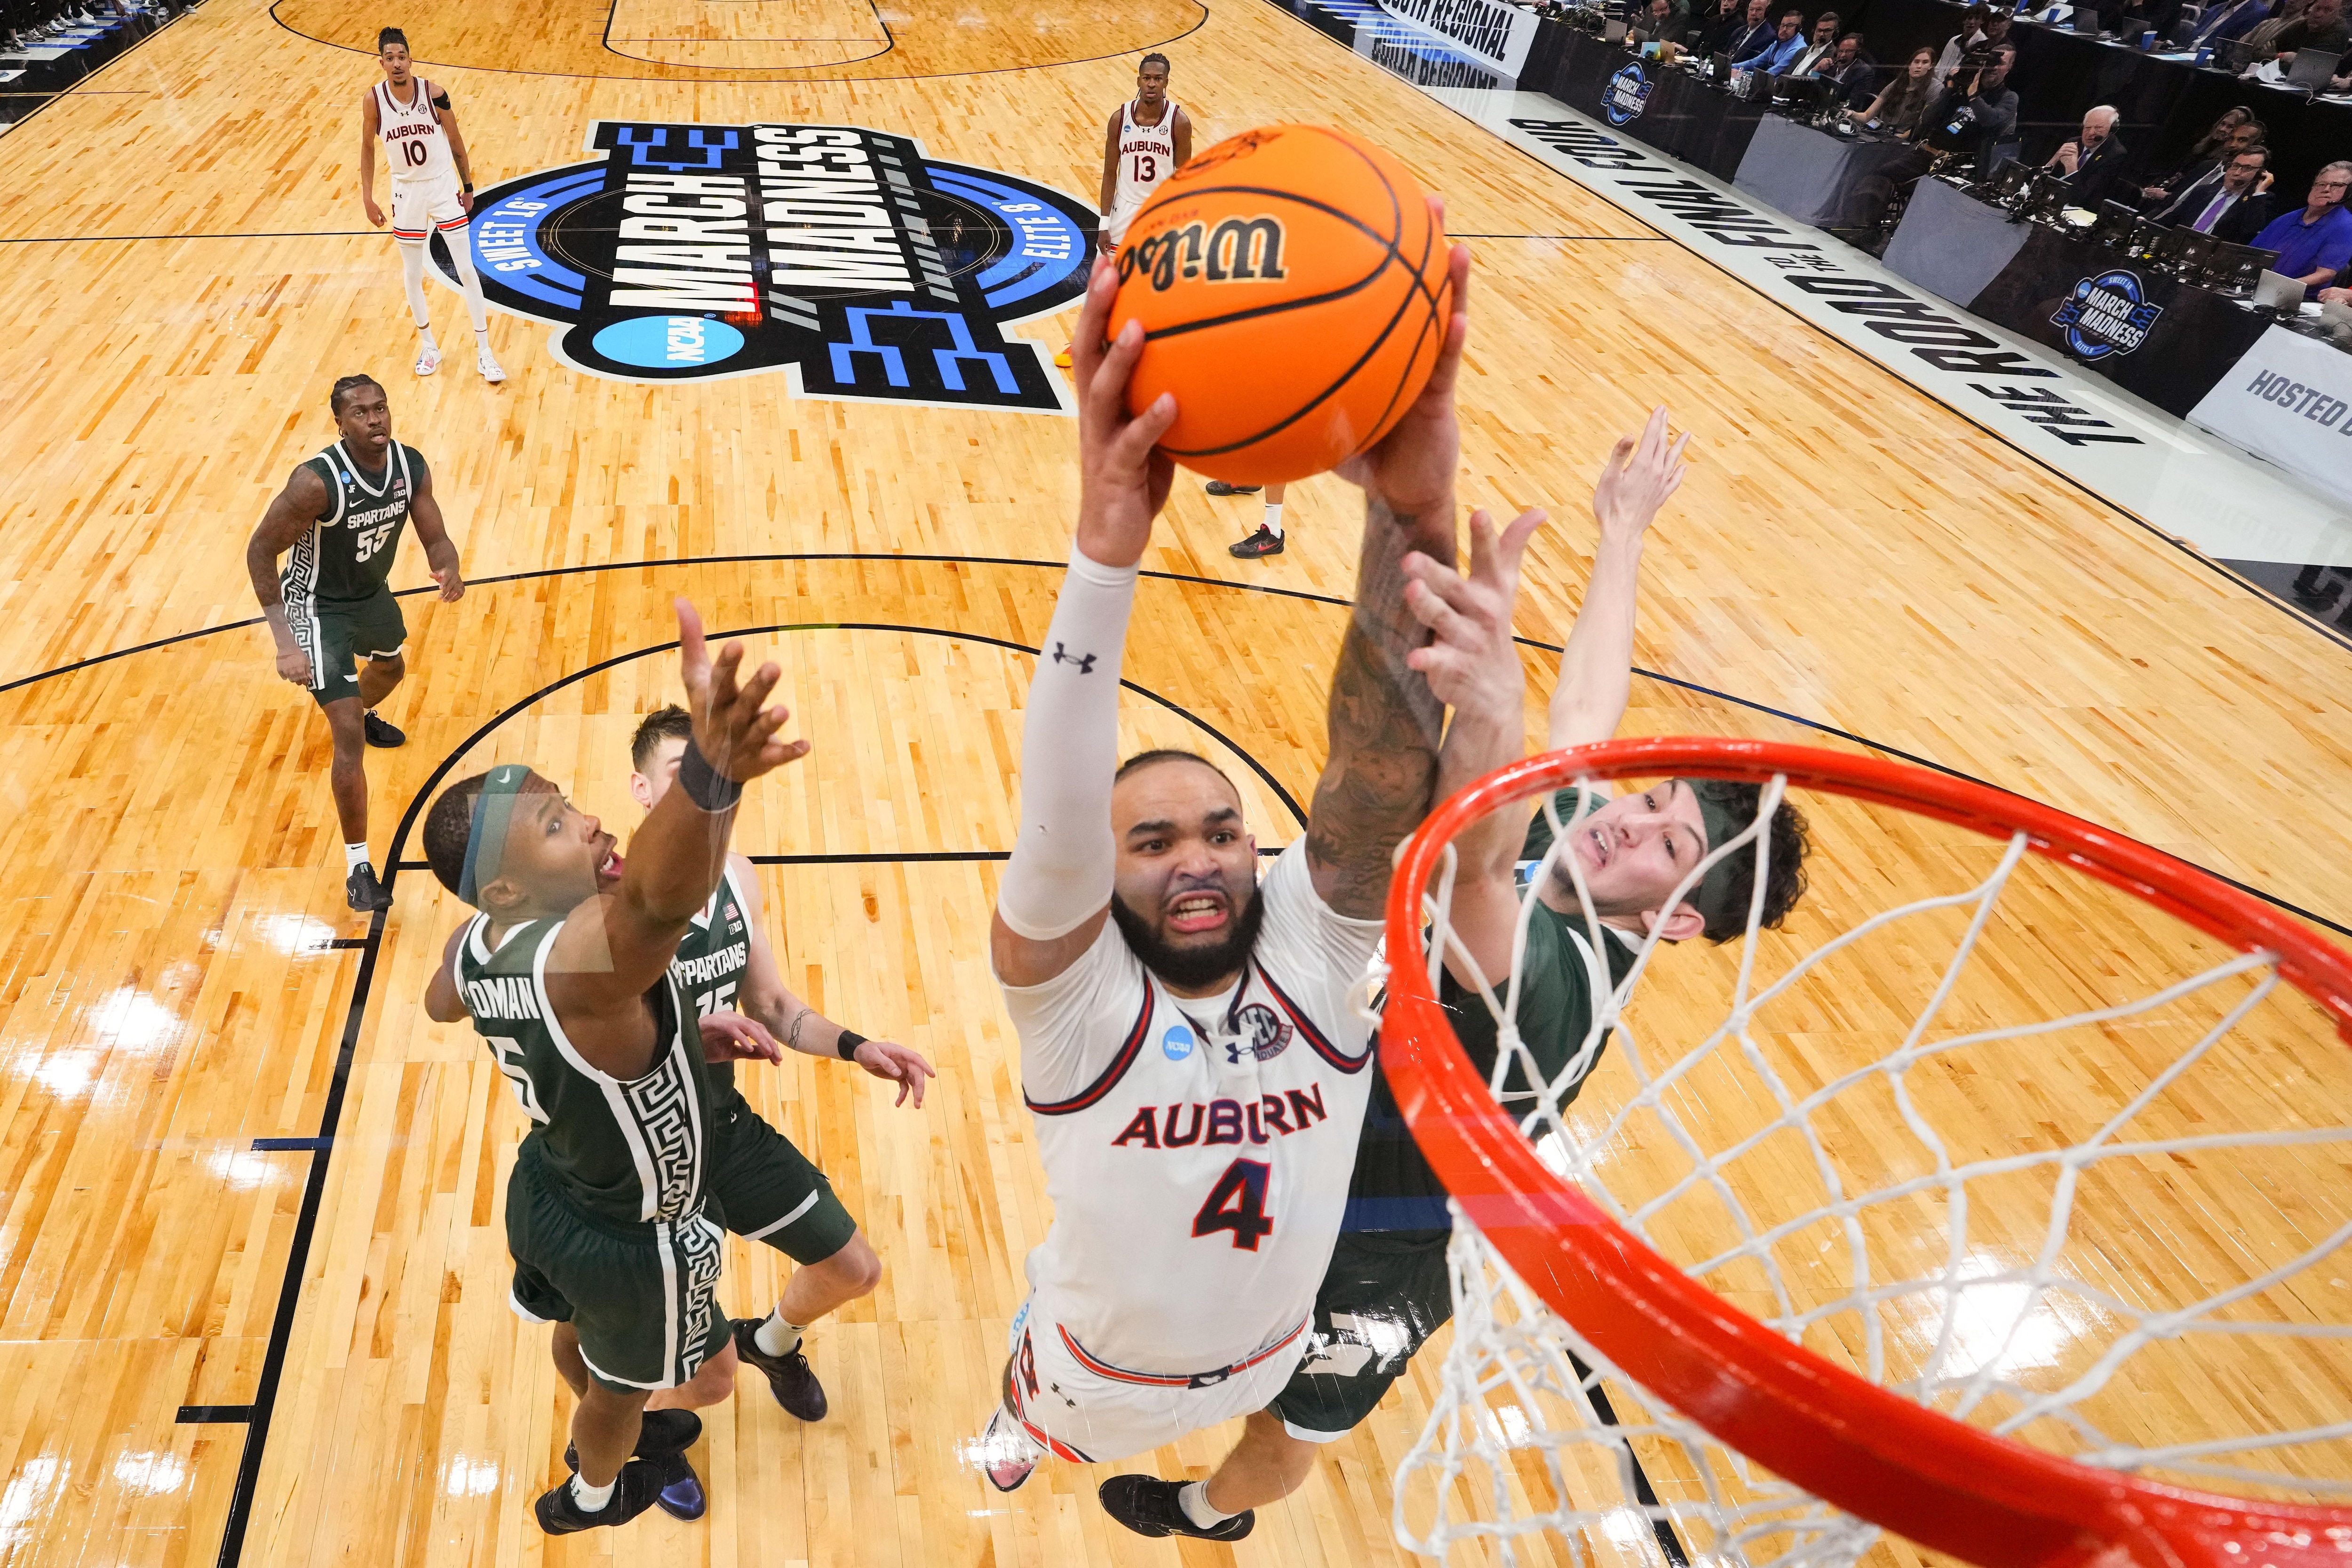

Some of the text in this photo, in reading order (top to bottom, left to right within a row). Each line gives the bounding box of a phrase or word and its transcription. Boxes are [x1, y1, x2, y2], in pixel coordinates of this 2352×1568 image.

[1430, 0, 1514, 62] REGIONAL
[1613, 89, 1645, 112] MADNESS
[1616, 76, 1640, 95] MARCH
[386, 124, 434, 143] AUBURN
[402, 140, 427, 166] 10
[1121, 141, 1170, 157] AUBURN
[1508, 118, 1675, 173] FOUR
[1134, 155, 1156, 182] 13
[754, 127, 915, 291] MADNESS
[1613, 180, 1824, 251] FINAL
[478, 201, 548, 271] SWEET 16
[609, 173, 756, 312] MARCH
[999, 203, 1071, 260] ELITE 8
[1118, 217, 1285, 292] Wilso
[1790, 252, 1846, 272] THE
[2108, 276, 2128, 285] SWEET
[2085, 287, 2135, 321] MARCH
[666, 317, 705, 362] NCAA
[1783, 275, 2064, 378] ROAD
[2075, 340, 2089, 353] ELITE
[2079, 307, 2144, 348] MADNESS
[1966, 383, 2146, 446] THE
[2246, 369, 2348, 427] HOSTED
[348, 484, 356, 493] JF
[347, 500, 405, 529] SPARTANS
[356, 521, 396, 563] 55
[468, 977, 541, 1020] OMAN
[1166, 1041, 1190, 1053] NCAA
[1111, 1083, 1327, 1149] AUBURN
[1191, 1157, 1274, 1252] 4
